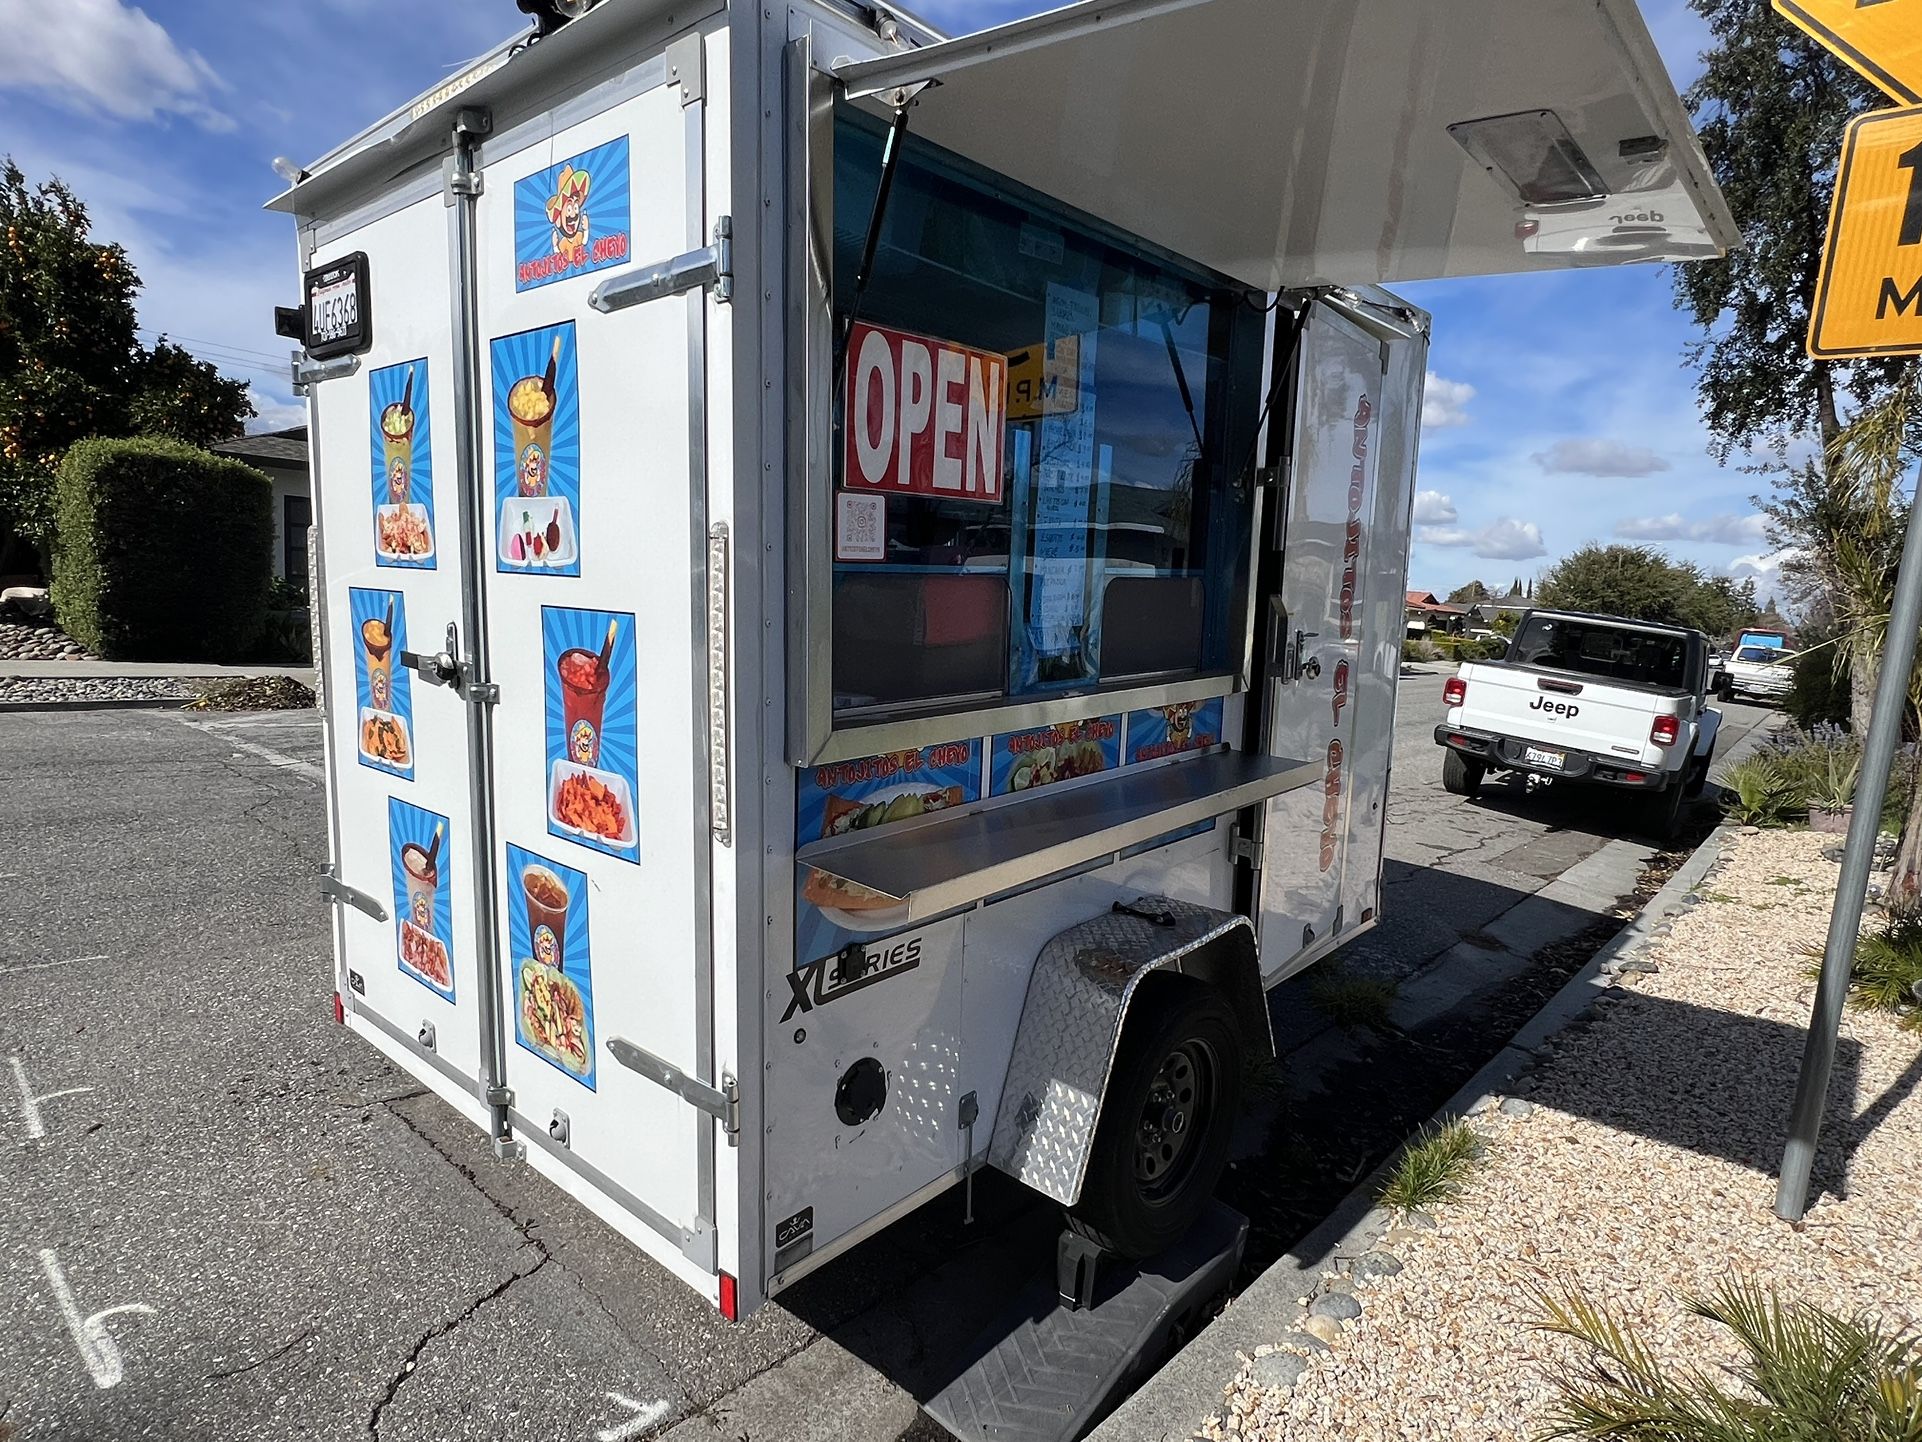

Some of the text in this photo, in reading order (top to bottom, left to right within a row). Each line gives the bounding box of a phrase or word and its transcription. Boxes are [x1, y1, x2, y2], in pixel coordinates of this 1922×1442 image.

[573, 244, 589, 268] EL
[855, 330, 1000, 494] OPEN
[1331, 658, 1350, 727] EL
[1529, 696, 1579, 719] Jeep
[1069, 726, 1083, 744] EL
[816, 744, 970, 790] ANTOJITOS EL CHEYO
[828, 937, 922, 991] SRIES
